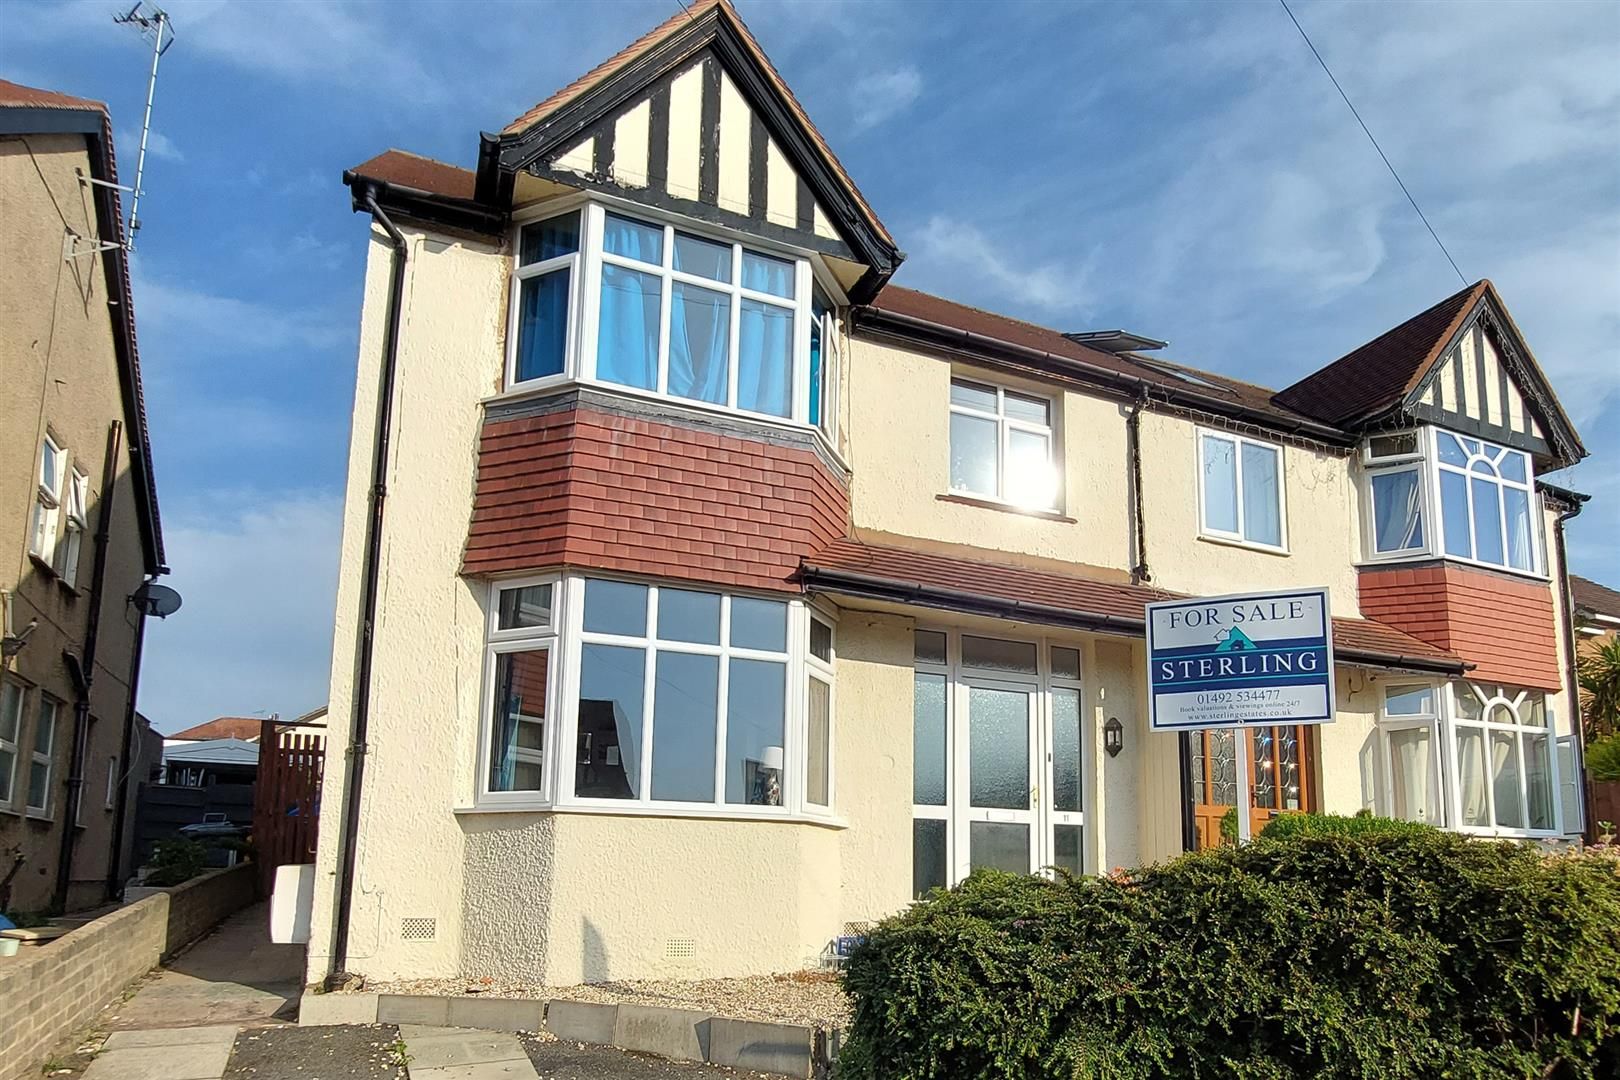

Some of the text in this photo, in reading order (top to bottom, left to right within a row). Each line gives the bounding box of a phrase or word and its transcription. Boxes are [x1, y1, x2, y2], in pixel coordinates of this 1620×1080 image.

[1169, 600, 1304, 629] FOR SALE
[1161, 651, 1318, 680] STERLING
[1197, 689, 1280, 704] 01492 534477
[1188, 709, 1292, 721] www.sterlingestates.co.uk
